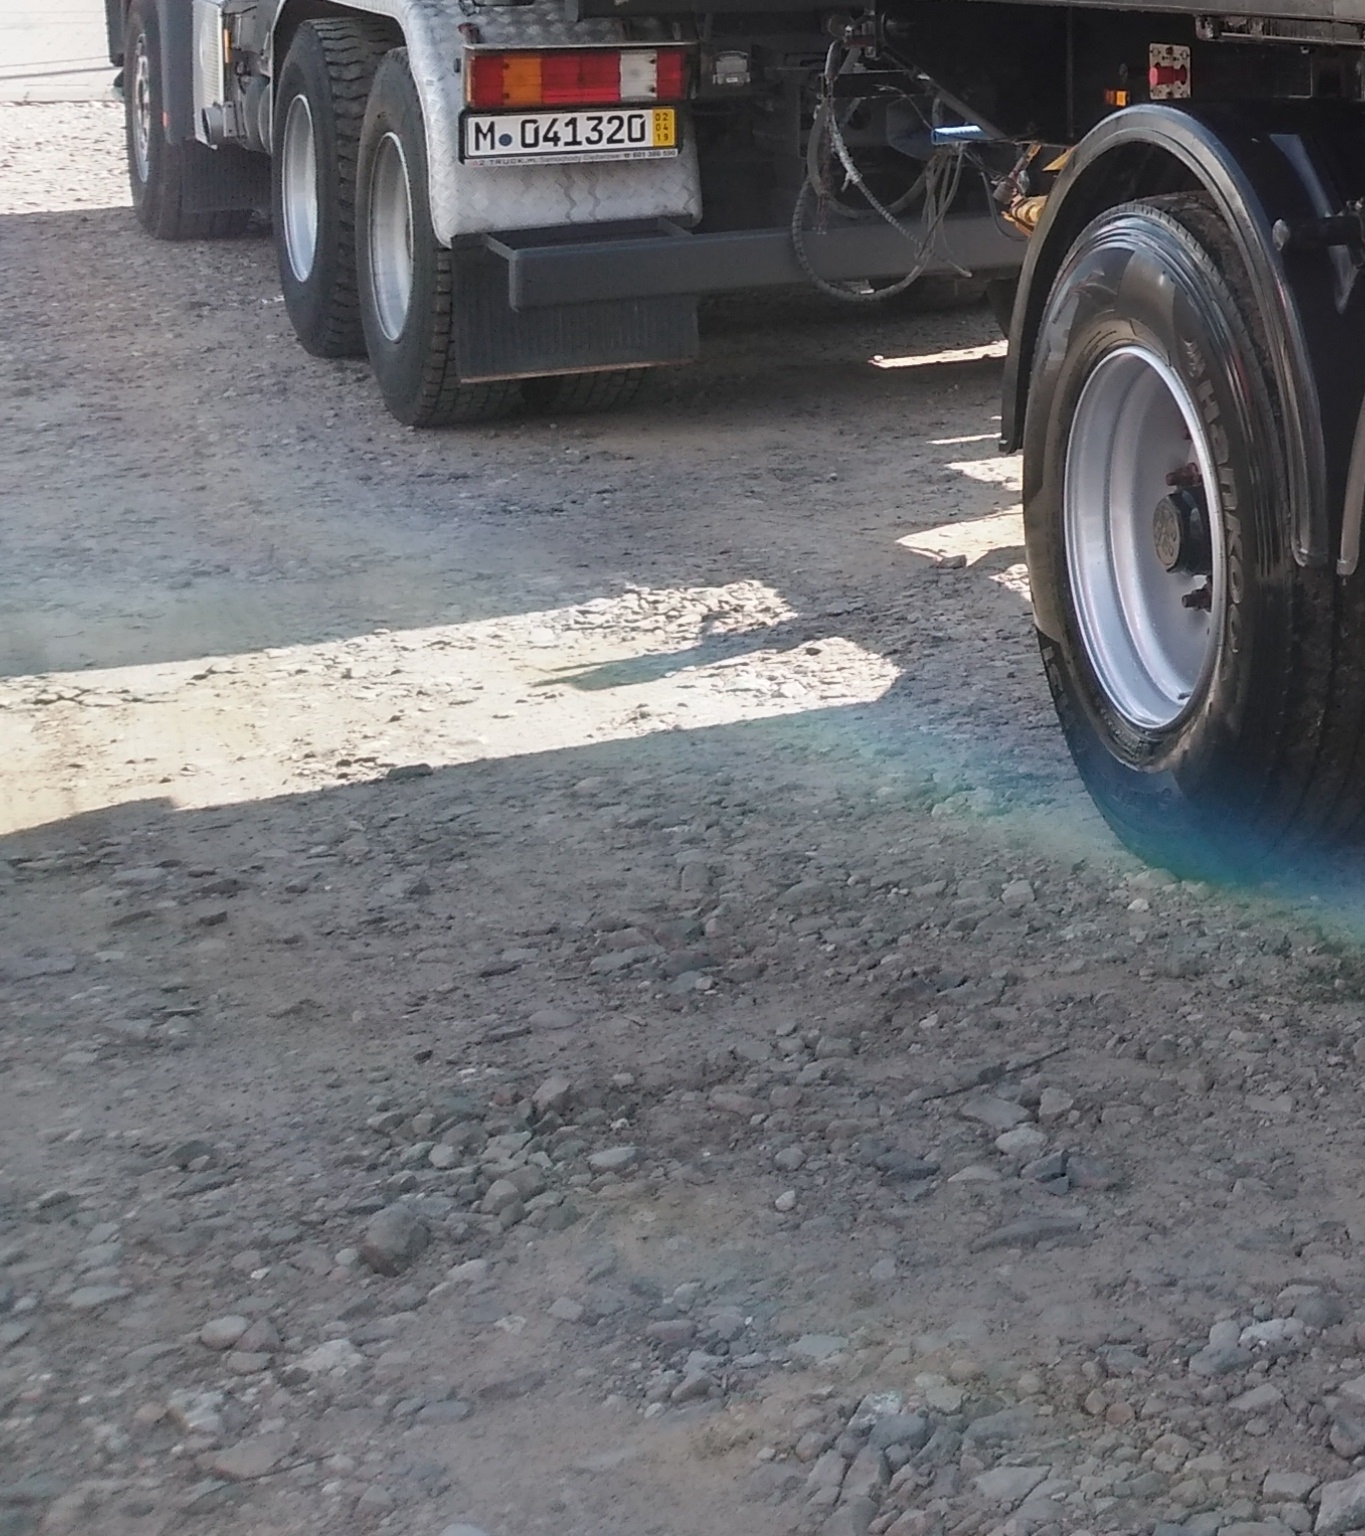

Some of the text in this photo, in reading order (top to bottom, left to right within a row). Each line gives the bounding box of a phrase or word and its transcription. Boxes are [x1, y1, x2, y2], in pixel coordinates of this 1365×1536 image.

[655, 112, 669, 122] 02
[655, 123, 669, 132] 04
[474, 114, 646, 151] M 041320
[656, 133, 669, 142] 19
